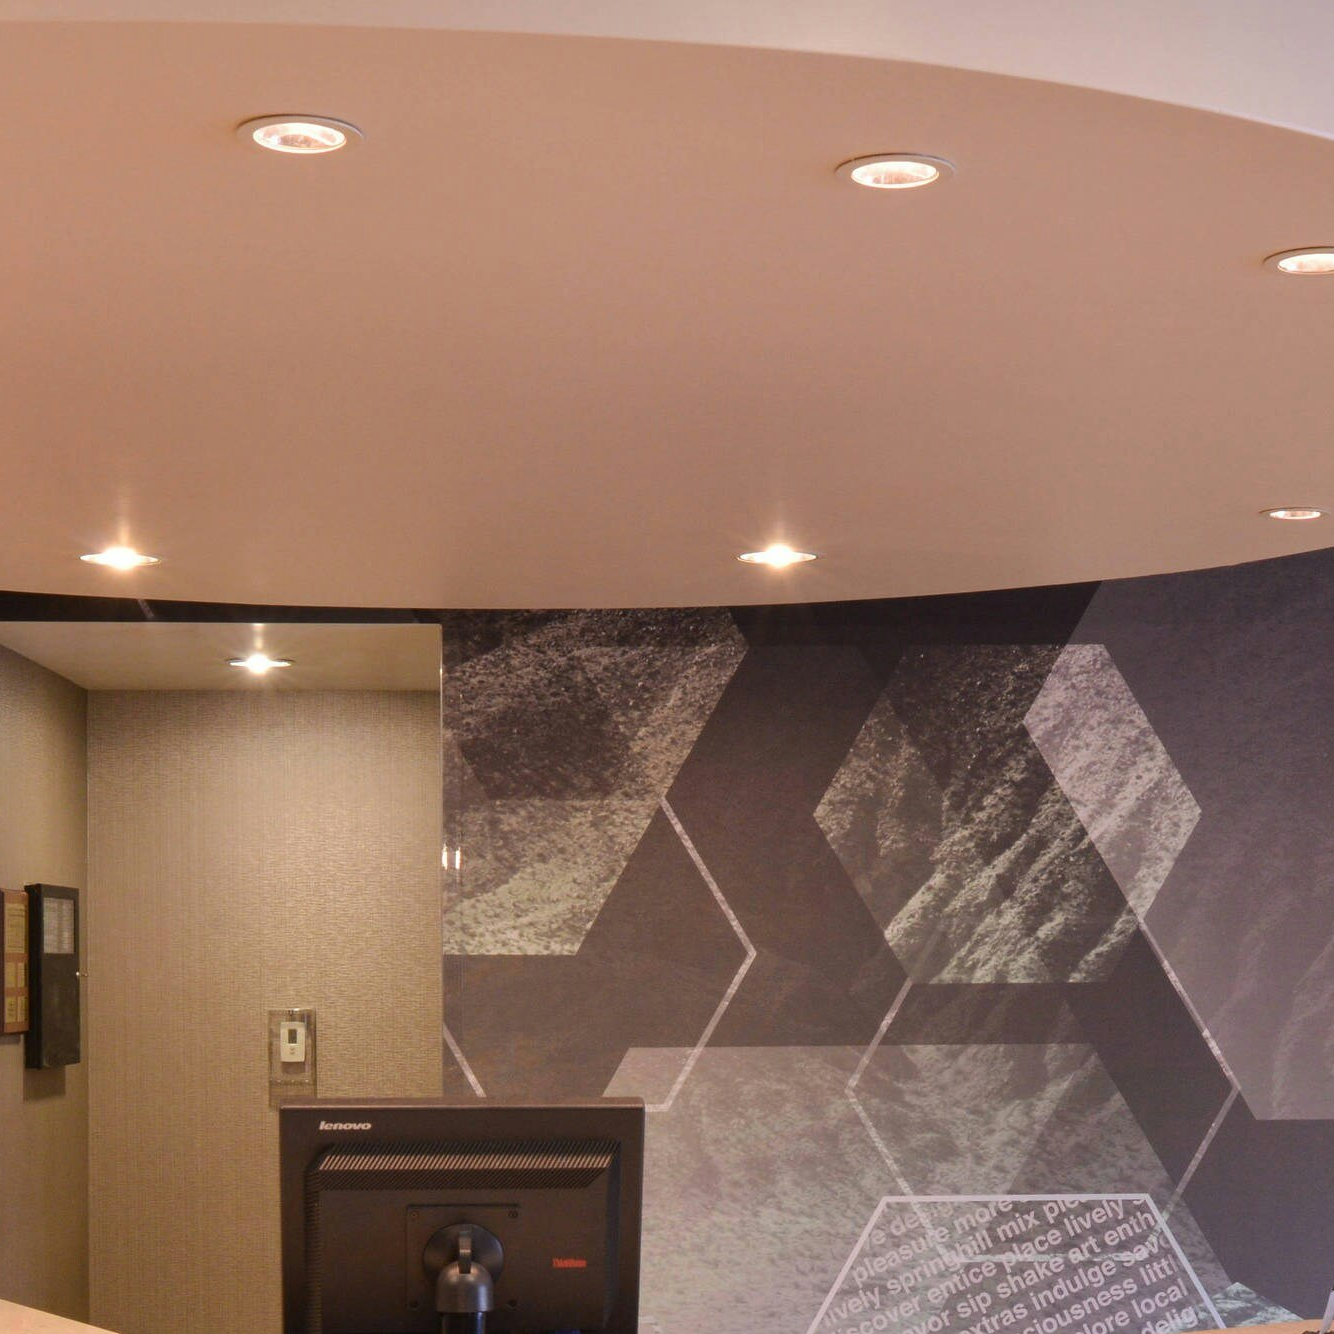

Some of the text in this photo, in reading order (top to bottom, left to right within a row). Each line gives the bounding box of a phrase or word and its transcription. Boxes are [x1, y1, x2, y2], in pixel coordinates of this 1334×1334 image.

[319, 1120, 372, 1131] lenovo
[853, 1226, 949, 1287] pleasure
[886, 1212, 1037, 1294] springhill mix
[927, 1261, 995, 1303] entice
[999, 1229, 1060, 1273] place
[1062, 1198, 1126, 1236] lively
[956, 1291, 994, 1317] sip
[996, 1256, 1063, 1297] shake
[1067, 1234, 1098, 1263] art
[1030, 1259, 1116, 1308] indulge
